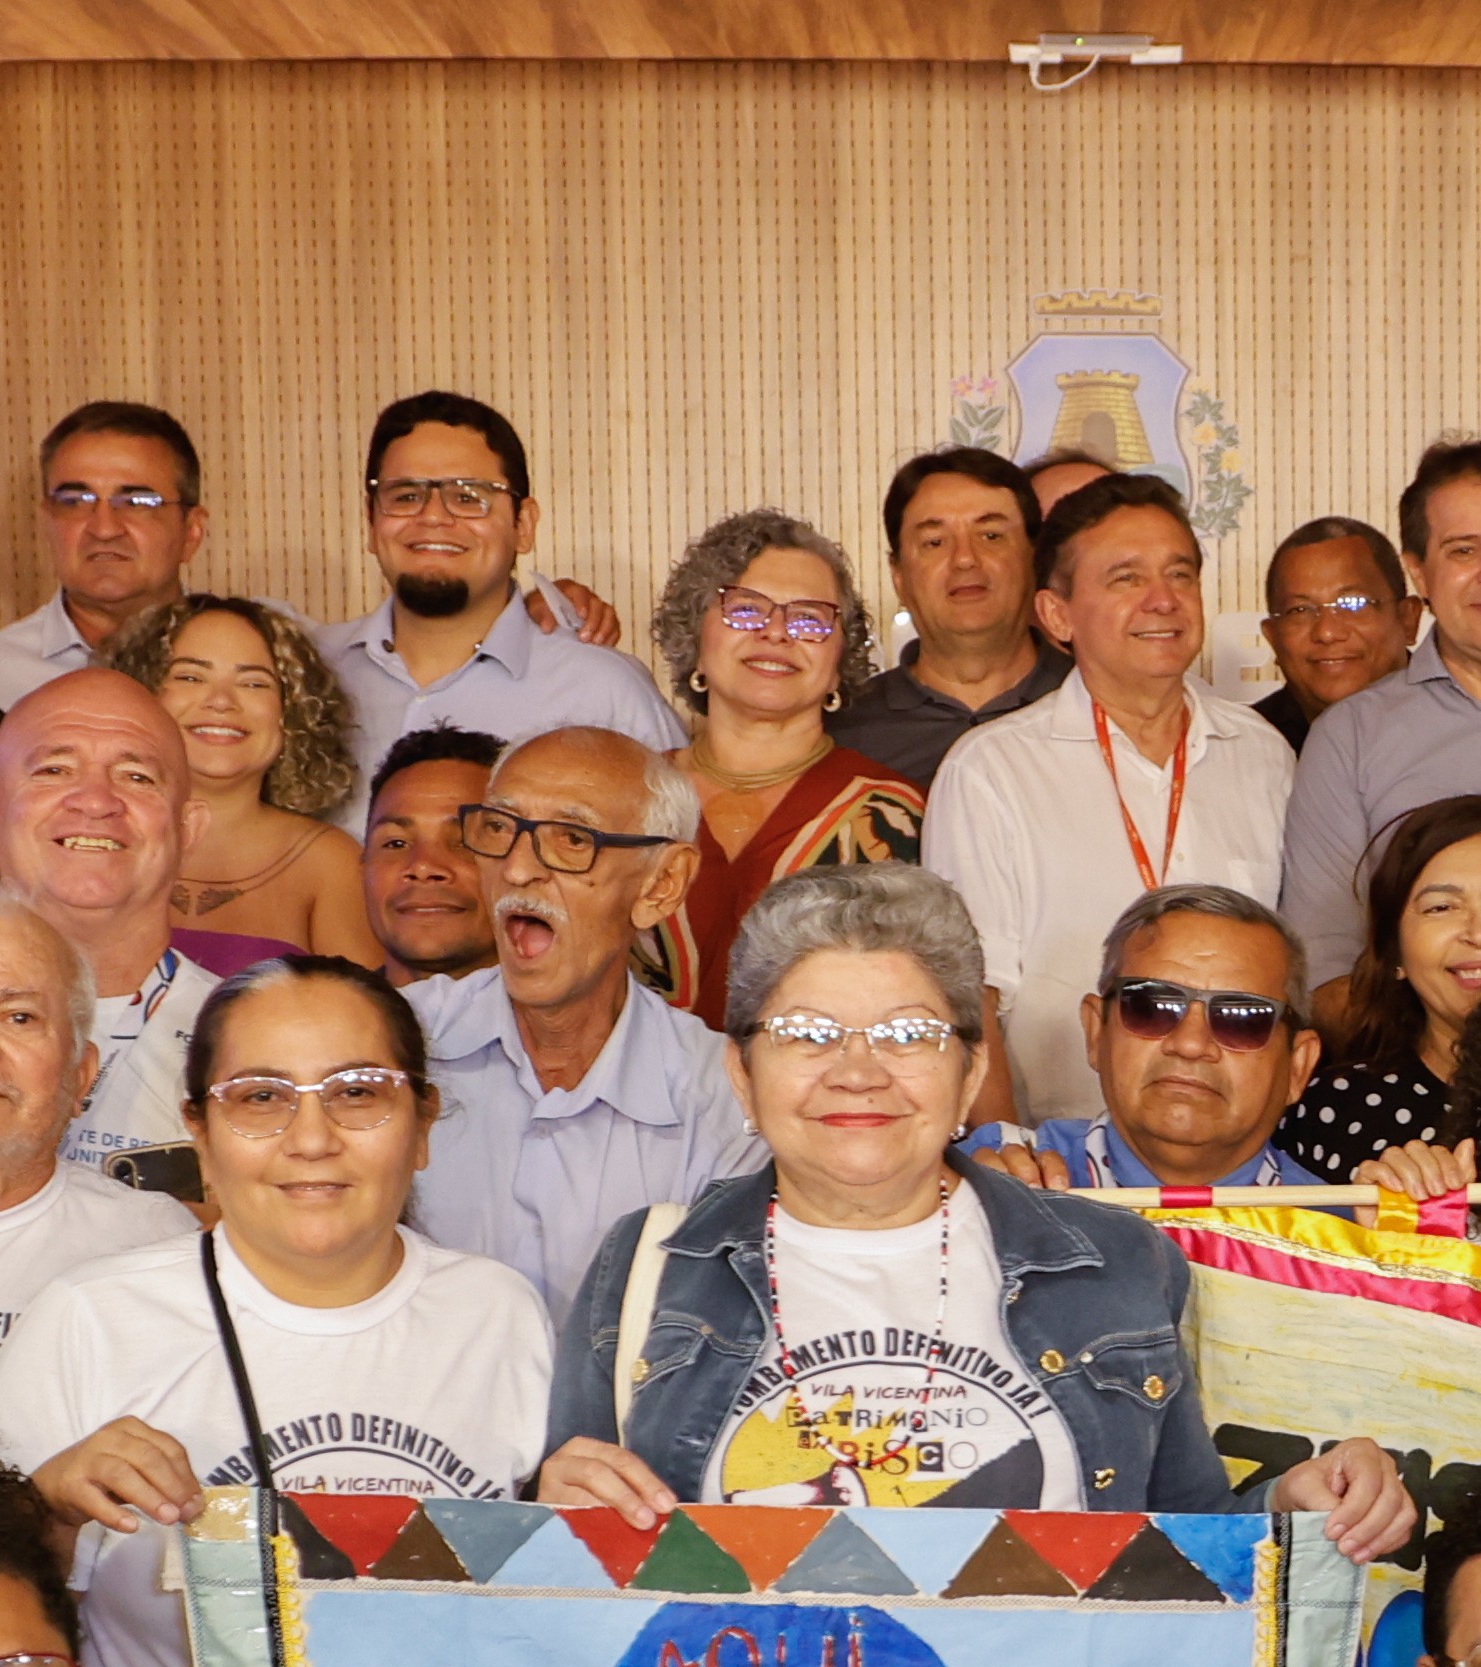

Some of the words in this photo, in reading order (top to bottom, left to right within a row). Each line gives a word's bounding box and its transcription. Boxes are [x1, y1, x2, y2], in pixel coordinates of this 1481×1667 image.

[101, 1133, 125, 1149] DE
[810, 1383, 855, 1397] VILA
[863, 1384, 969, 1400] VICENTINA
[350, 1413, 476, 1488] DEFINITIVO
[280, 1474, 328, 1491] VILA
[334, 1475, 436, 1495] VICENTINA
